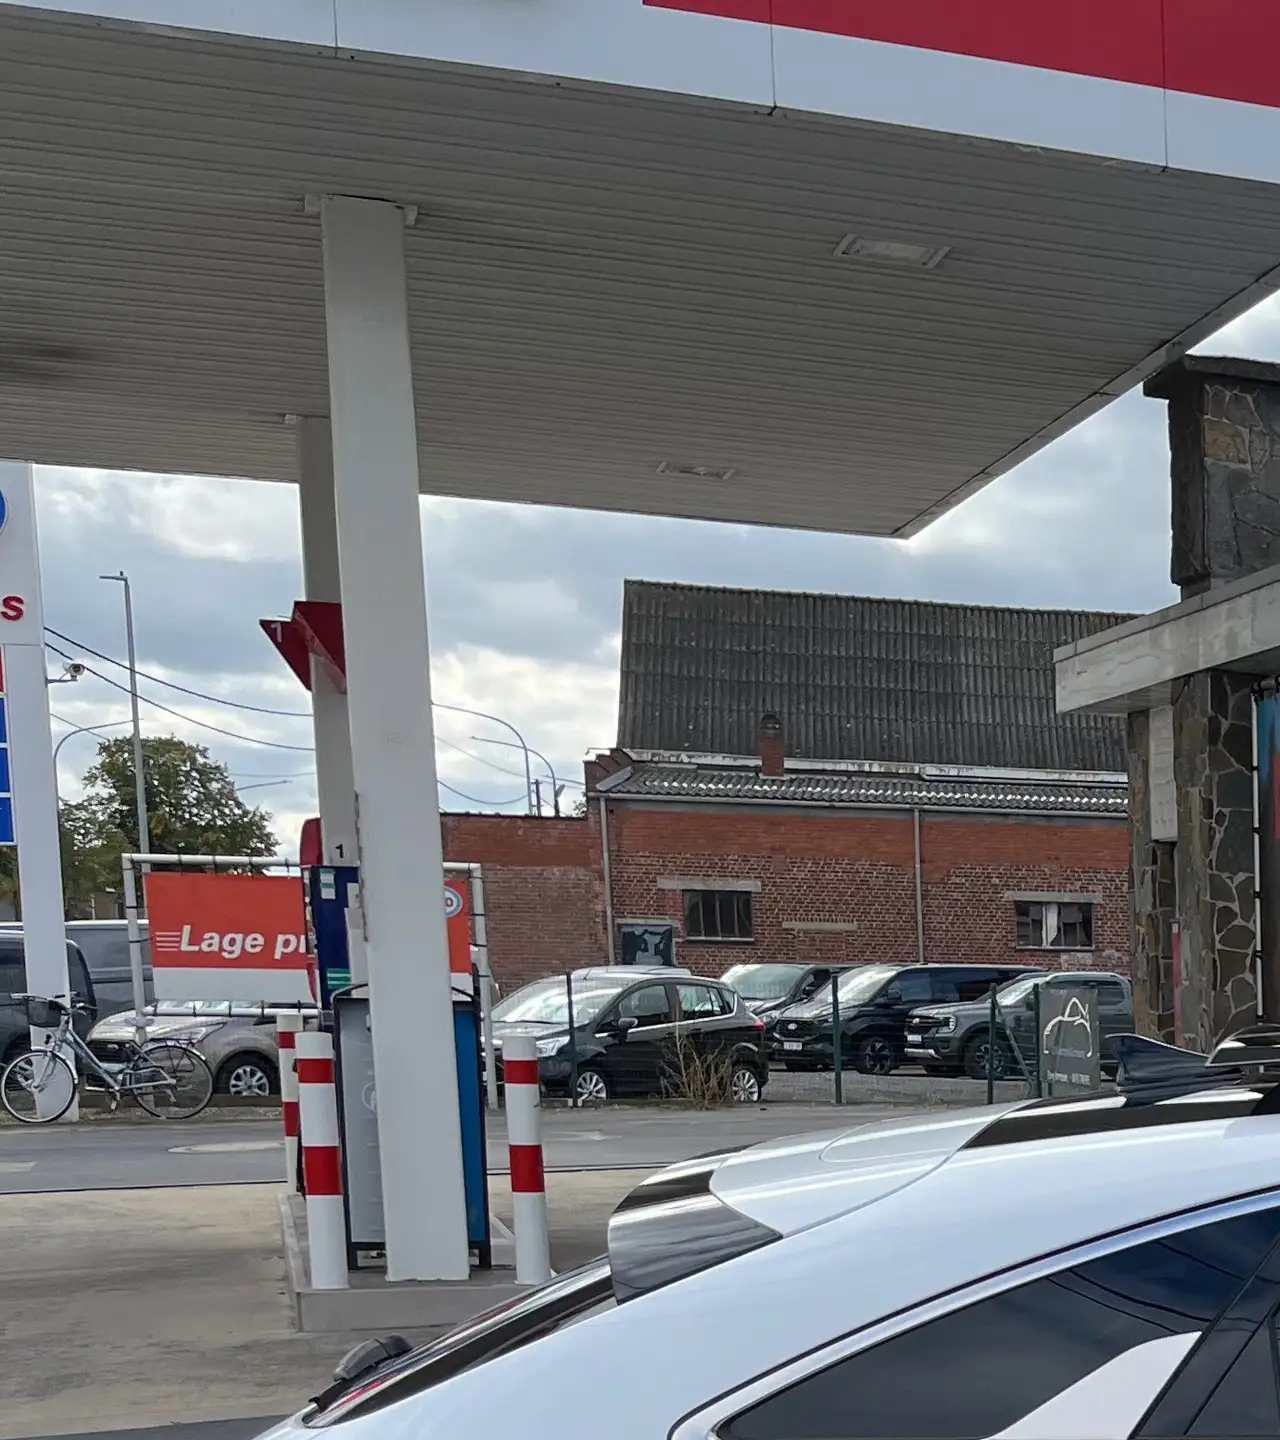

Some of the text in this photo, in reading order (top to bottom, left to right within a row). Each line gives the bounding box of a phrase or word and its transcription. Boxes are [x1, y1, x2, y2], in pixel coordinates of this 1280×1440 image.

[270, 622, 282, 643] 1
[336, 844, 344, 859] 1
[180, 925, 265, 959] Lage
